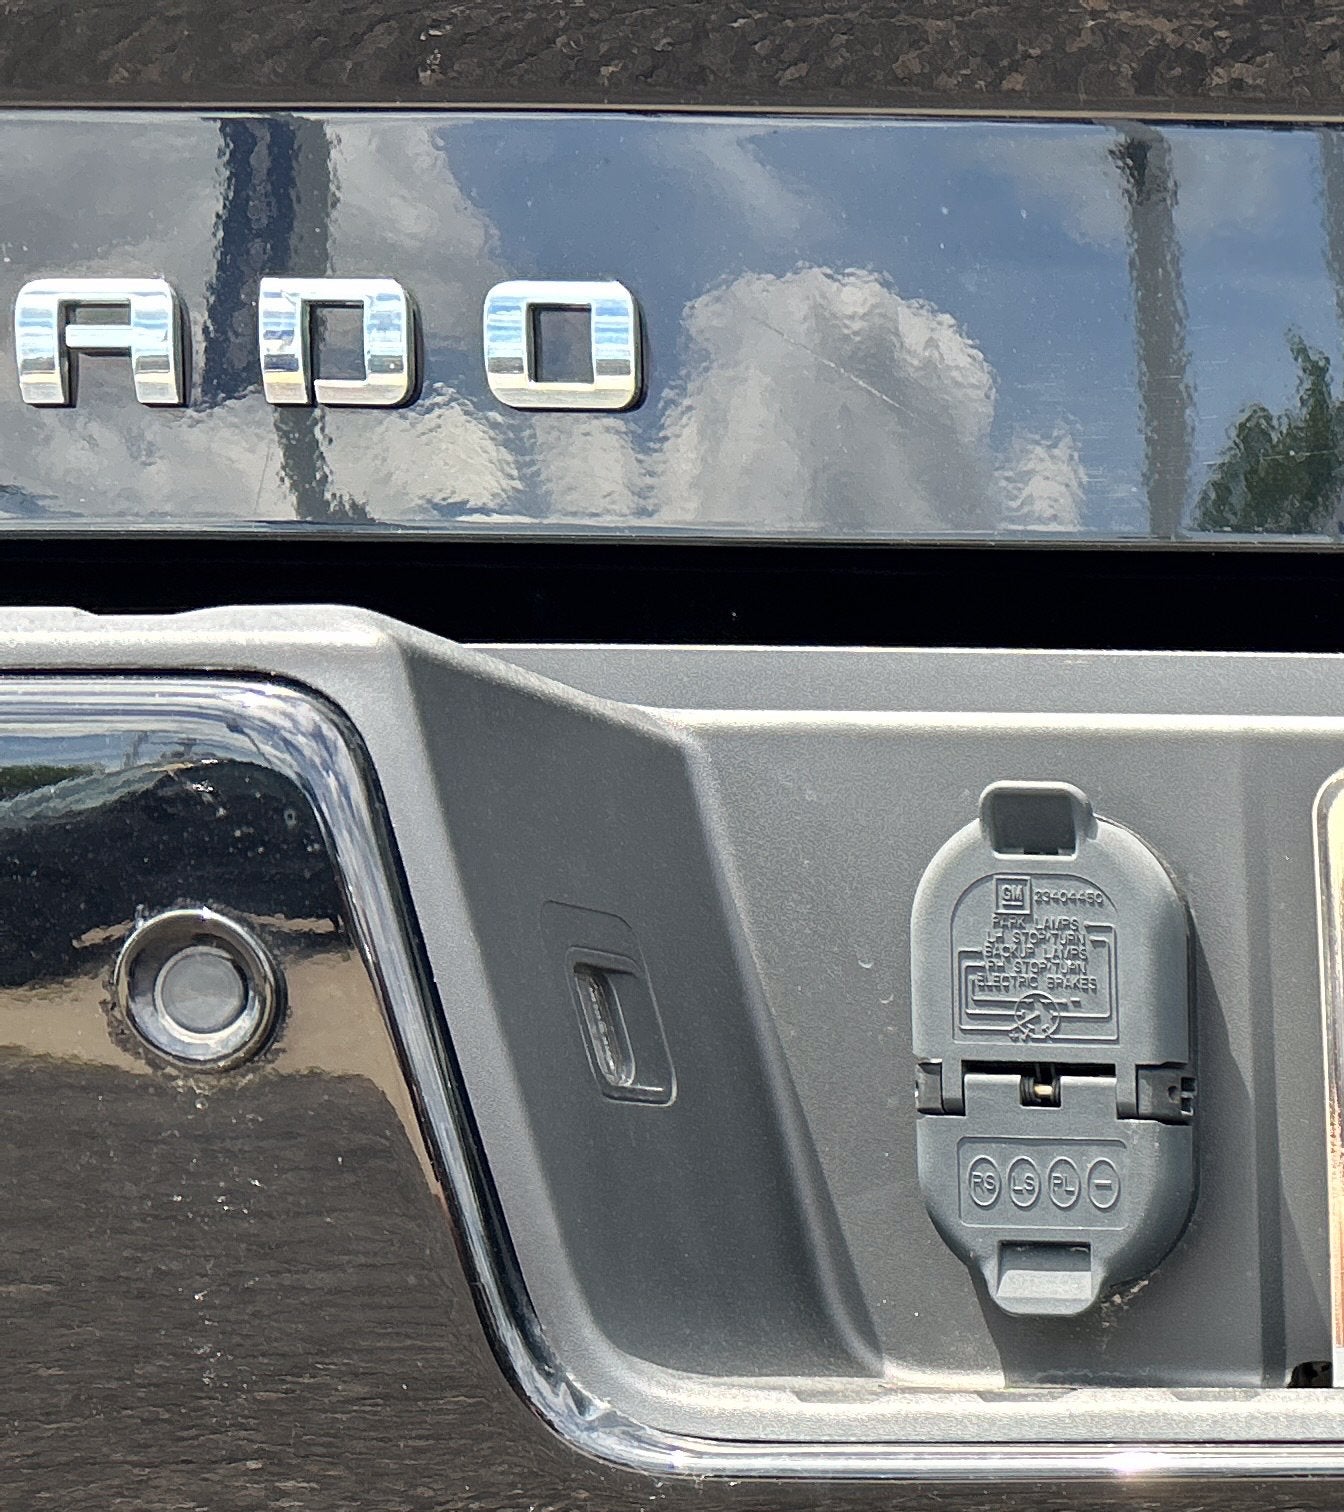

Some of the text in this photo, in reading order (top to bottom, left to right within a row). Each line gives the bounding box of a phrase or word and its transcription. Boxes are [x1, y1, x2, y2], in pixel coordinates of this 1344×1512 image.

[14, 277, 643, 410] ADO
[1002, 885, 1024, 901] GM
[992, 913, 1080, 930] PARK LAMPS
[984, 943, 1088, 961] BACKUP LAMPS
[976, 973, 1097, 992] ELECTRIC BRAKES
[972, 1171, 1075, 1194] RS LS PL
